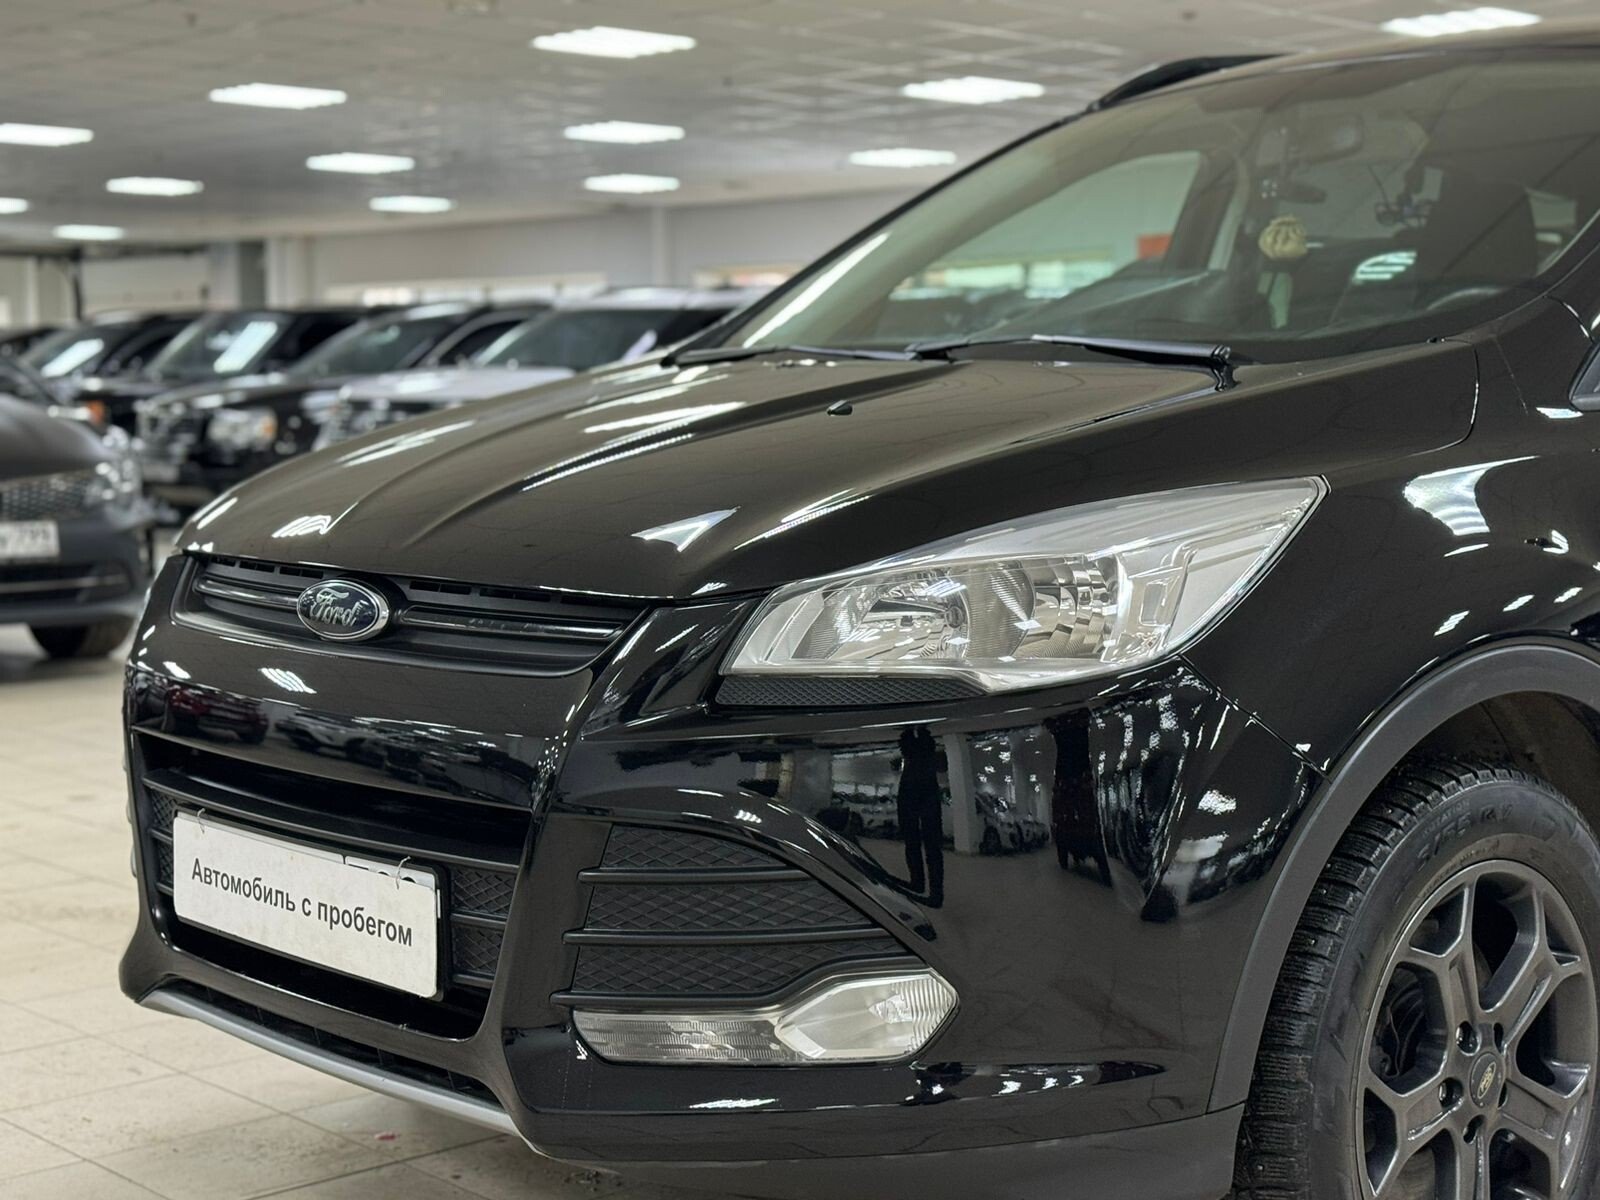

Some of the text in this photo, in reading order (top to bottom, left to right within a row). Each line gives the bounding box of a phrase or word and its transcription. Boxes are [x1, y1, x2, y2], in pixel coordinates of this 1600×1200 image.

[310, 588, 357, 627] Ford
[191, 858, 296, 912] Автомобиль
[302, 897, 312, 916] с
[317, 901, 413, 947] пробегом
